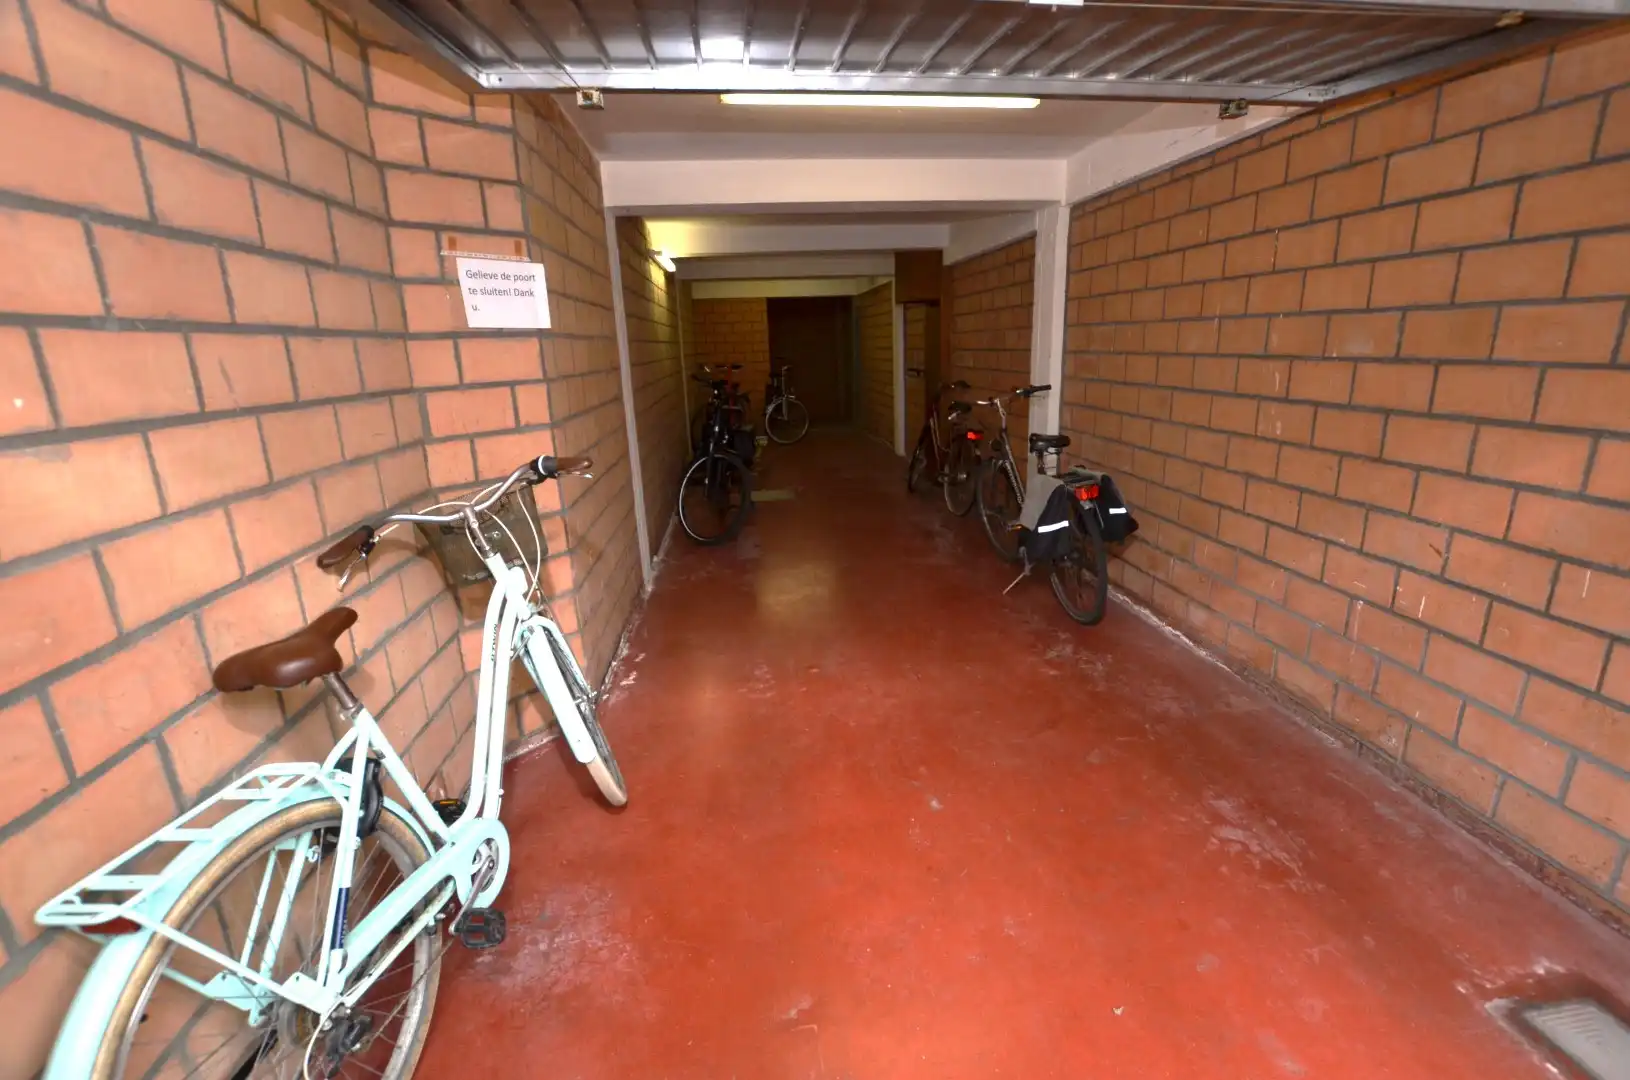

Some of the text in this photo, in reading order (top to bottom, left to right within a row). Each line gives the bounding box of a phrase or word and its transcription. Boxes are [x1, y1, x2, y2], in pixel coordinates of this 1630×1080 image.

[465, 269, 536, 283] Gelieve de poort
[468, 286, 535, 298] te sluiten! Dank
[471, 304, 480, 312] u.
